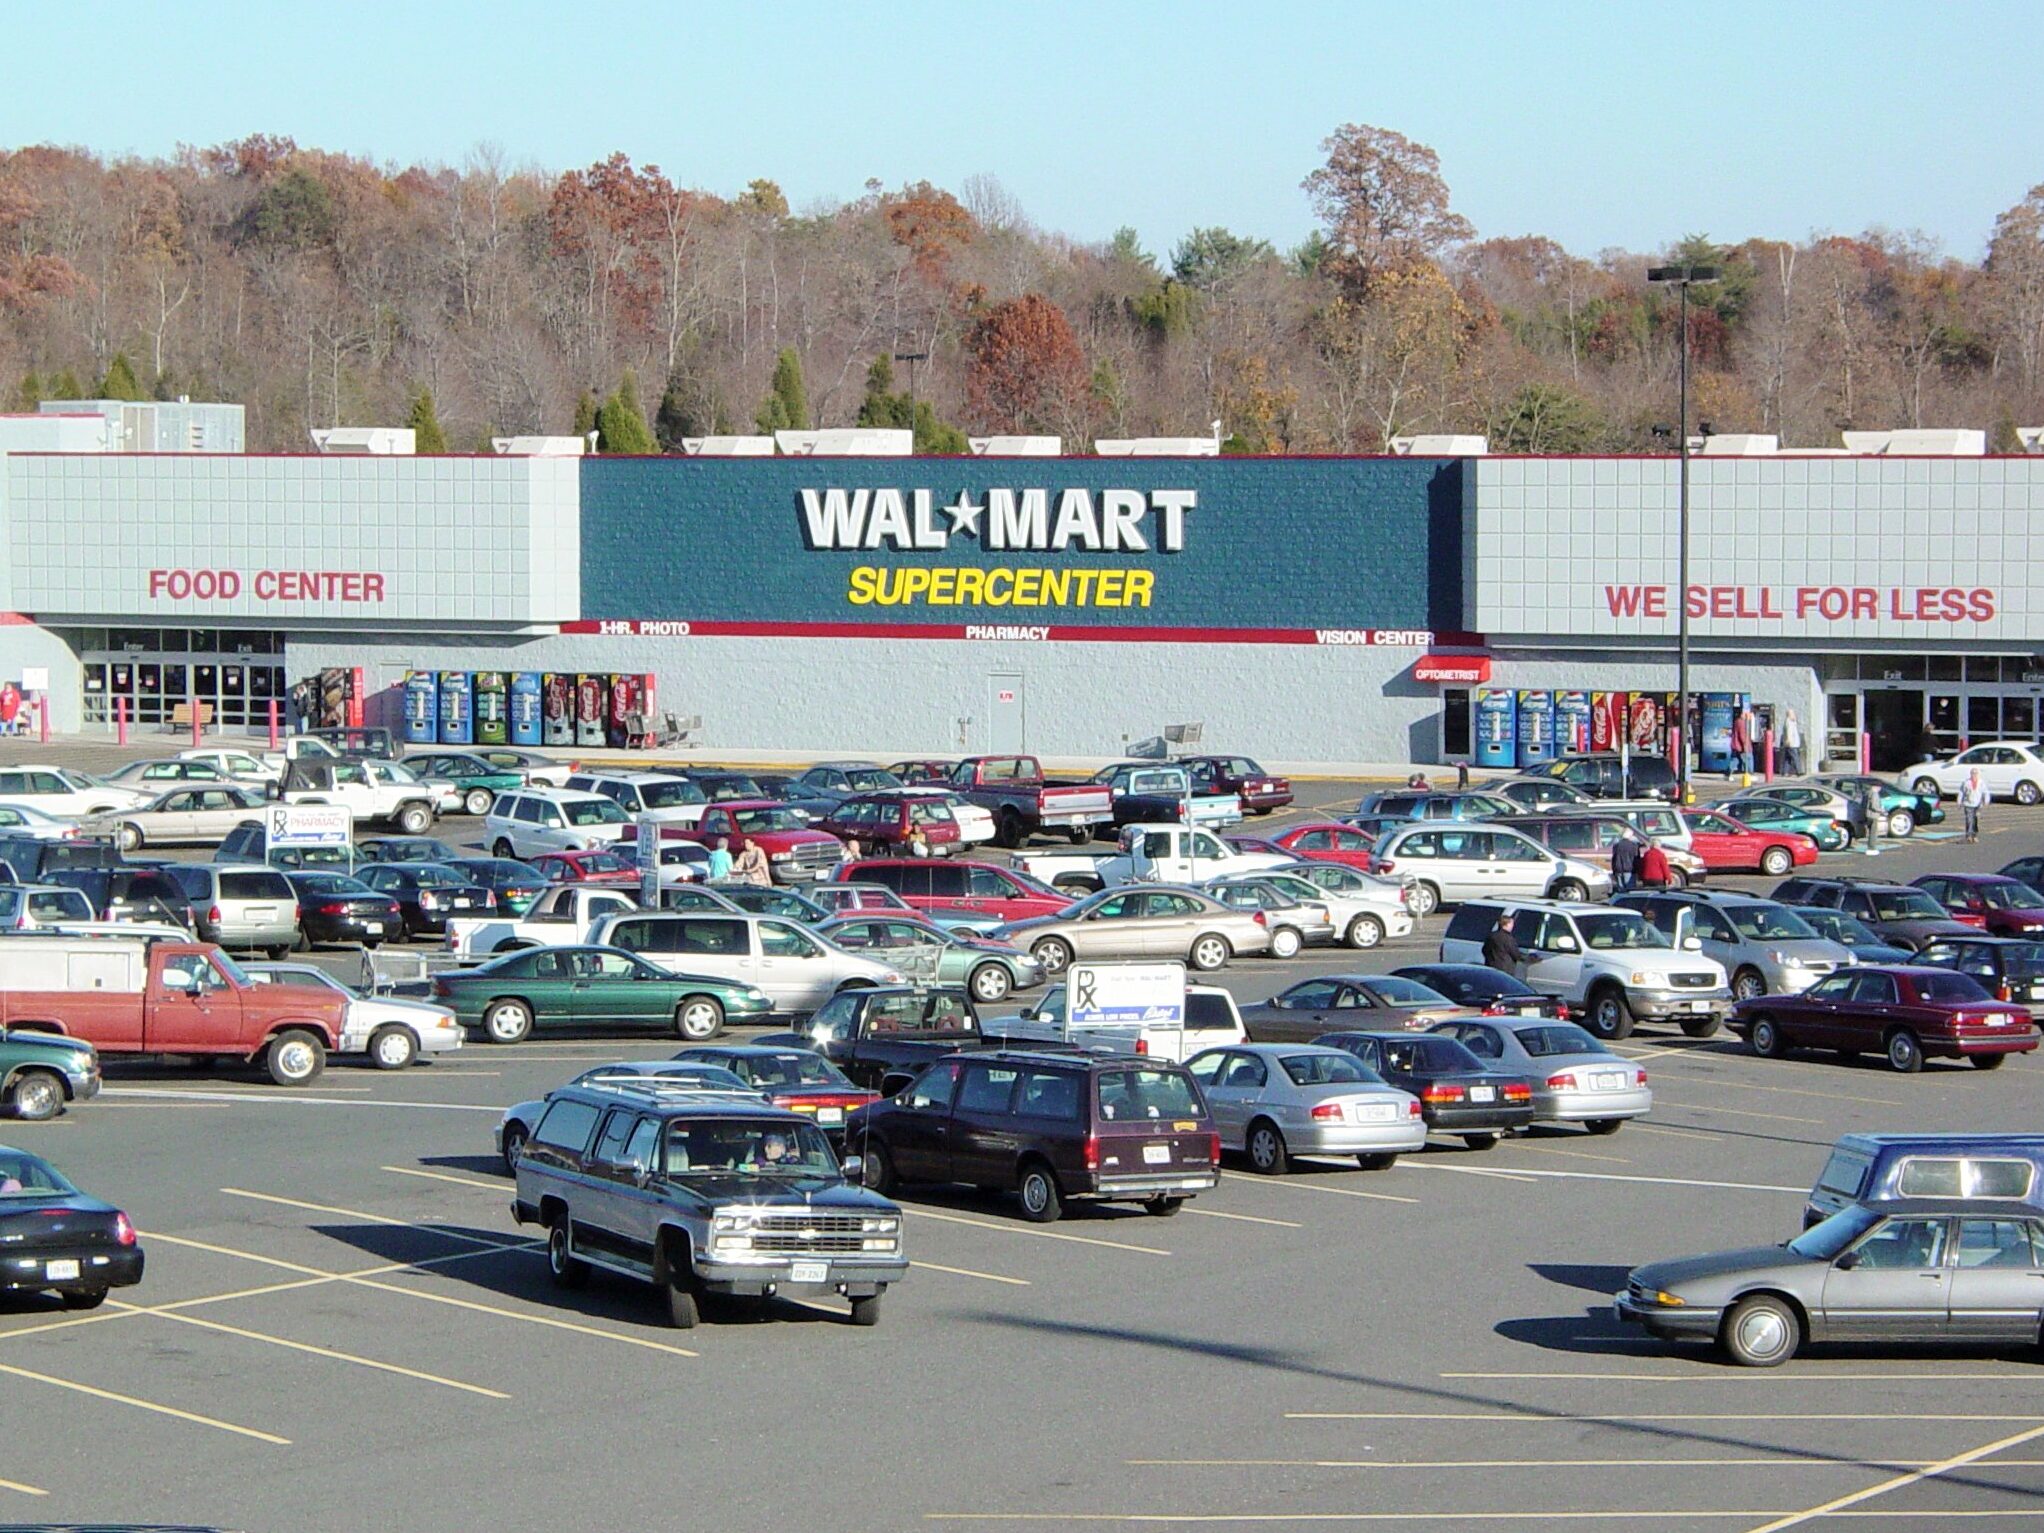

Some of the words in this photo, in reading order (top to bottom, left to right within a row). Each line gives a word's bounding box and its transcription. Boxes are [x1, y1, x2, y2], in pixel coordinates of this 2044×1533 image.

[149, 569, 241, 600] FOOD
[254, 570, 385, 602] CENTER
[848, 566, 1155, 607] SUPERCENTER
[1604, 585, 1667, 618] WE
[1686, 585, 1783, 619] SELL
[1796, 587, 1879, 620] FOR
[1890, 588, 1995, 622] LESS
[640, 621, 691, 636] PHOTO
[965, 625, 1050, 641] PHARMACY
[1315, 629, 1367, 645] VISION
[1373, 630, 1435, 646] CENTER
[1415, 669, 1481, 680] OPTOMETRIST
[1883, 670, 1903, 680] Exit
[290, 816, 346, 828] PHARMACY
